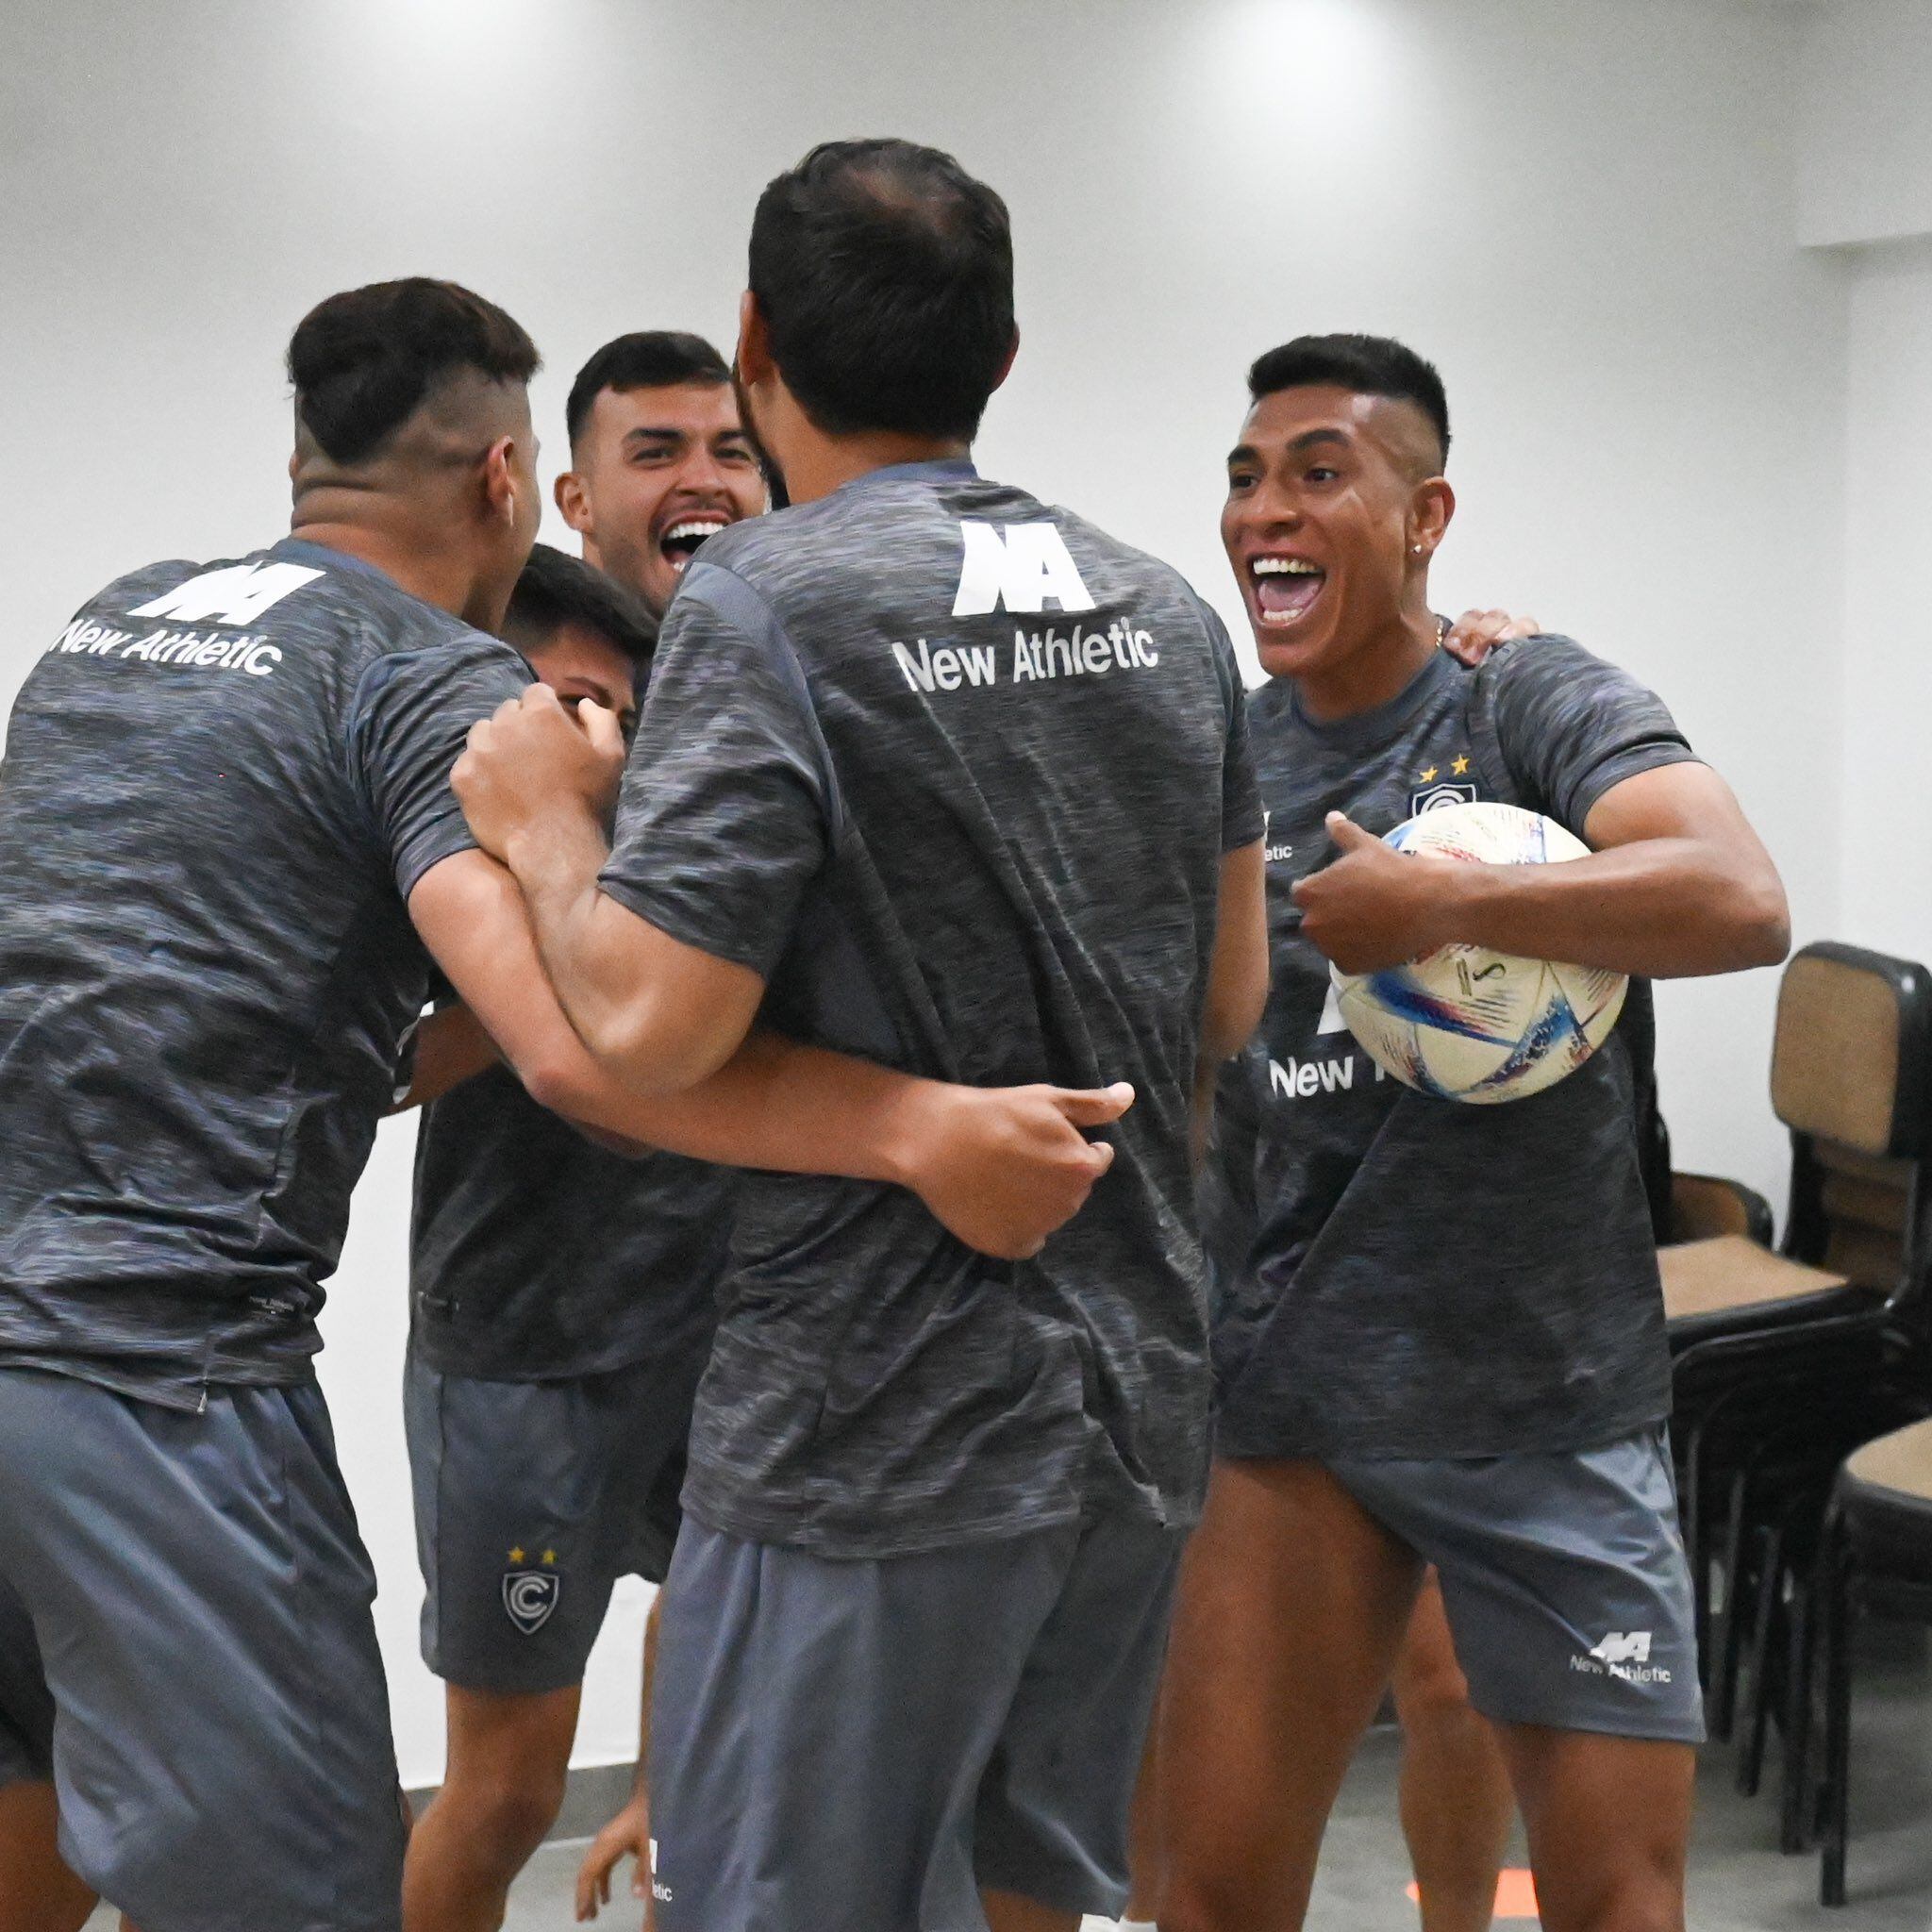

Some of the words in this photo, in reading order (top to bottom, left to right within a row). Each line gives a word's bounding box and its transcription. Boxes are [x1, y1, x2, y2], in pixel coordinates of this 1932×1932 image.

[49, 619, 133, 656] New
[121, 629, 283, 676] Athletic
[891, 638, 996, 692] New
[1013, 616, 1159, 683] Athletic
[1265, 843, 1293, 862] etic
[1269, 1056, 1354, 1099] New
